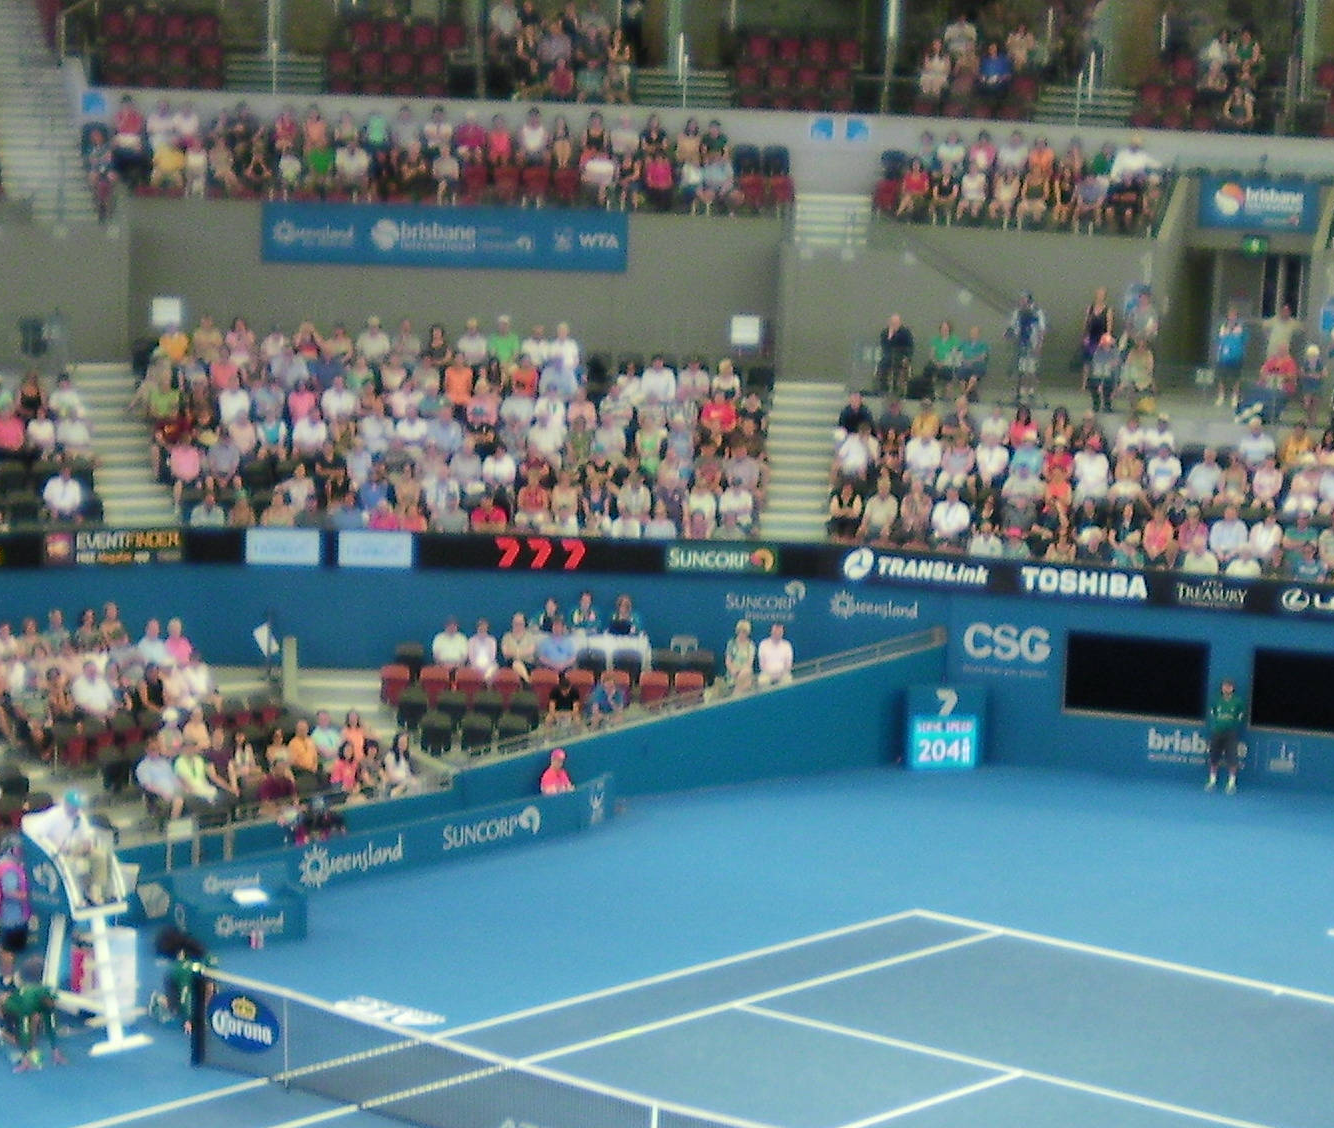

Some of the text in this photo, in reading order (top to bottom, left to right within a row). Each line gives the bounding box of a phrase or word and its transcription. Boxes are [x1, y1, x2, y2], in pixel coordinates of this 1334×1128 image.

[578, 232, 619, 249] WTA
[496, 536, 586, 571] 7 7 7
[1021, 566, 1148, 600] TOSHIBA
[1176, 582, 1248, 604] TREASURY
[724, 592, 796, 610] SUNCORP
[830, 590, 918, 619] Queensland
[963, 622, 1052, 664] CSG
[442, 817, 518, 851] SUNCORP
[299, 832, 404, 889] Queensland
[211, 1008, 273, 1046] Corona
